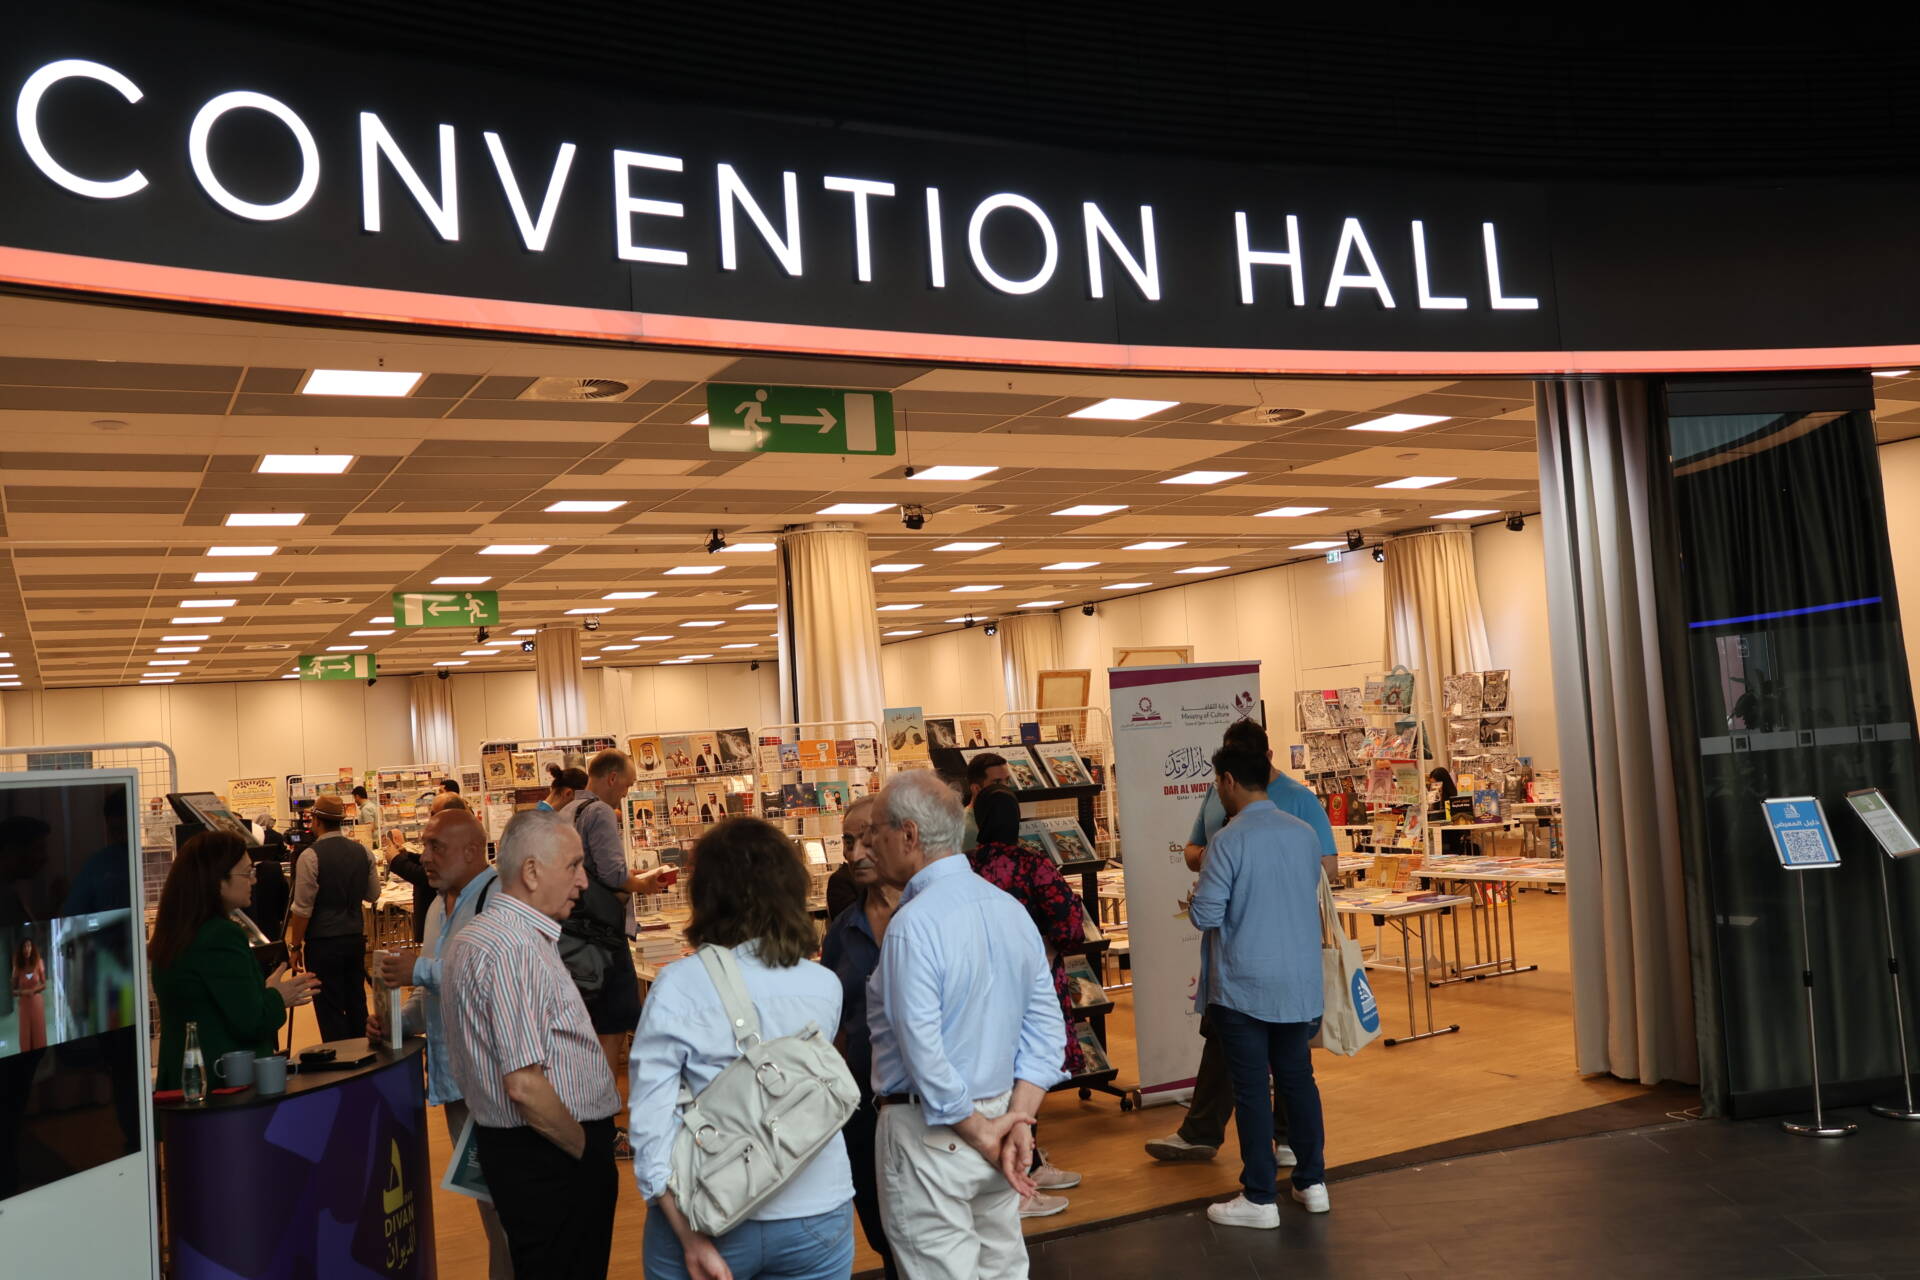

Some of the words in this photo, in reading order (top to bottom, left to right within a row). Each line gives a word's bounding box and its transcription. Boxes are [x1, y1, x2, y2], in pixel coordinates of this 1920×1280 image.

[16, 59, 1161, 301] CONVENTION
[1234, 211, 1539, 310] HALL
[1181, 712, 1203, 721] Ministry
[1210, 711, 1230, 719] Culture
[1163, 785, 1179, 796] DAR
[1180, 785, 1189, 794] AL
[384, 1201, 415, 1238] DIVAN
